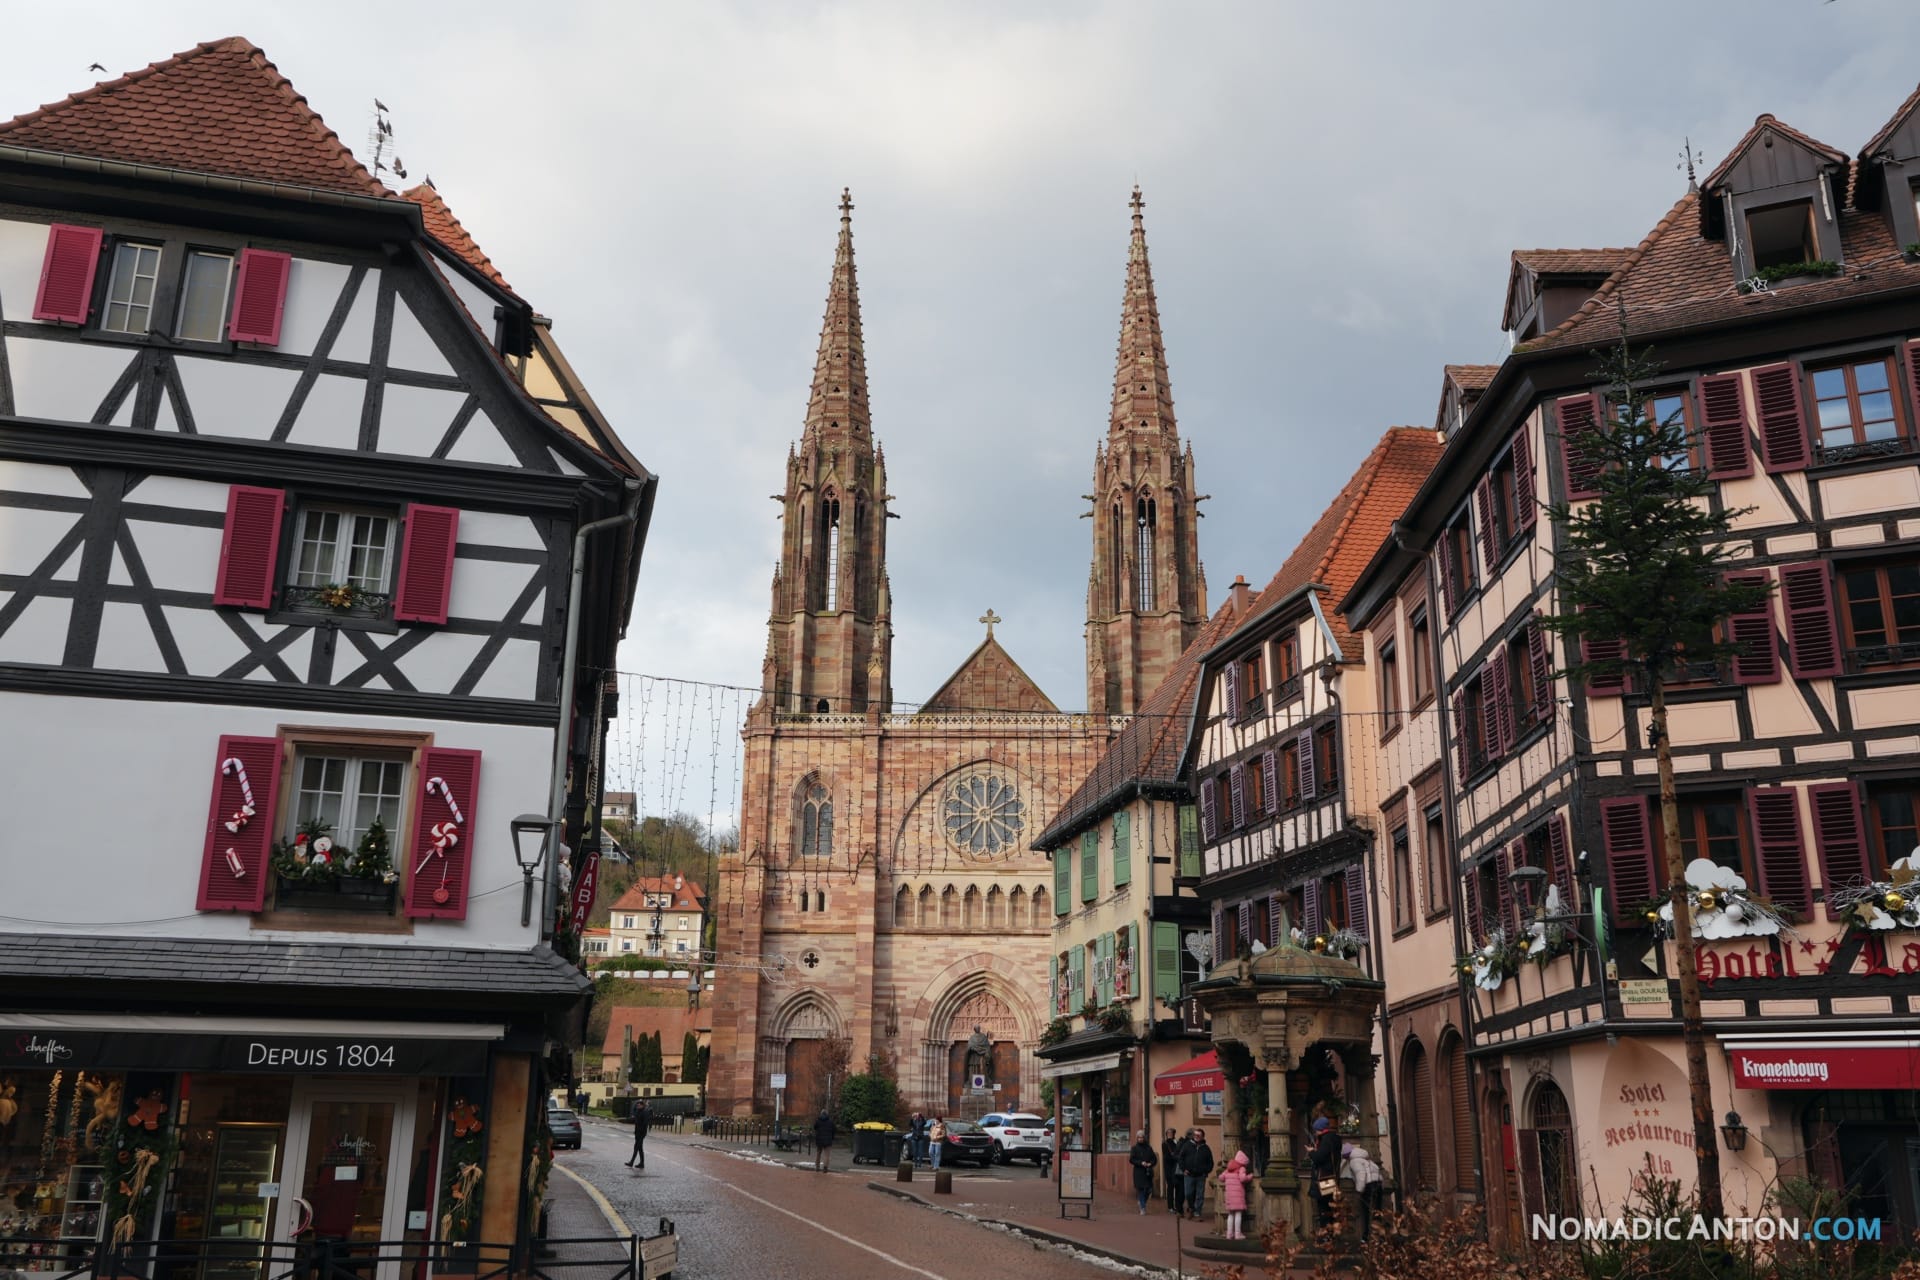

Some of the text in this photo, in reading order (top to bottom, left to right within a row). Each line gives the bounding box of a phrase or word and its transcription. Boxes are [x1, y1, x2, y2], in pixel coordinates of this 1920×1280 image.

[571, 856, 597, 936] TABAC
[248, 1043, 395, 1067] DEPUIS 1804
[1742, 1056, 1828, 1082] Kronenbourg
[1604, 1120, 1695, 1149] Restauran
